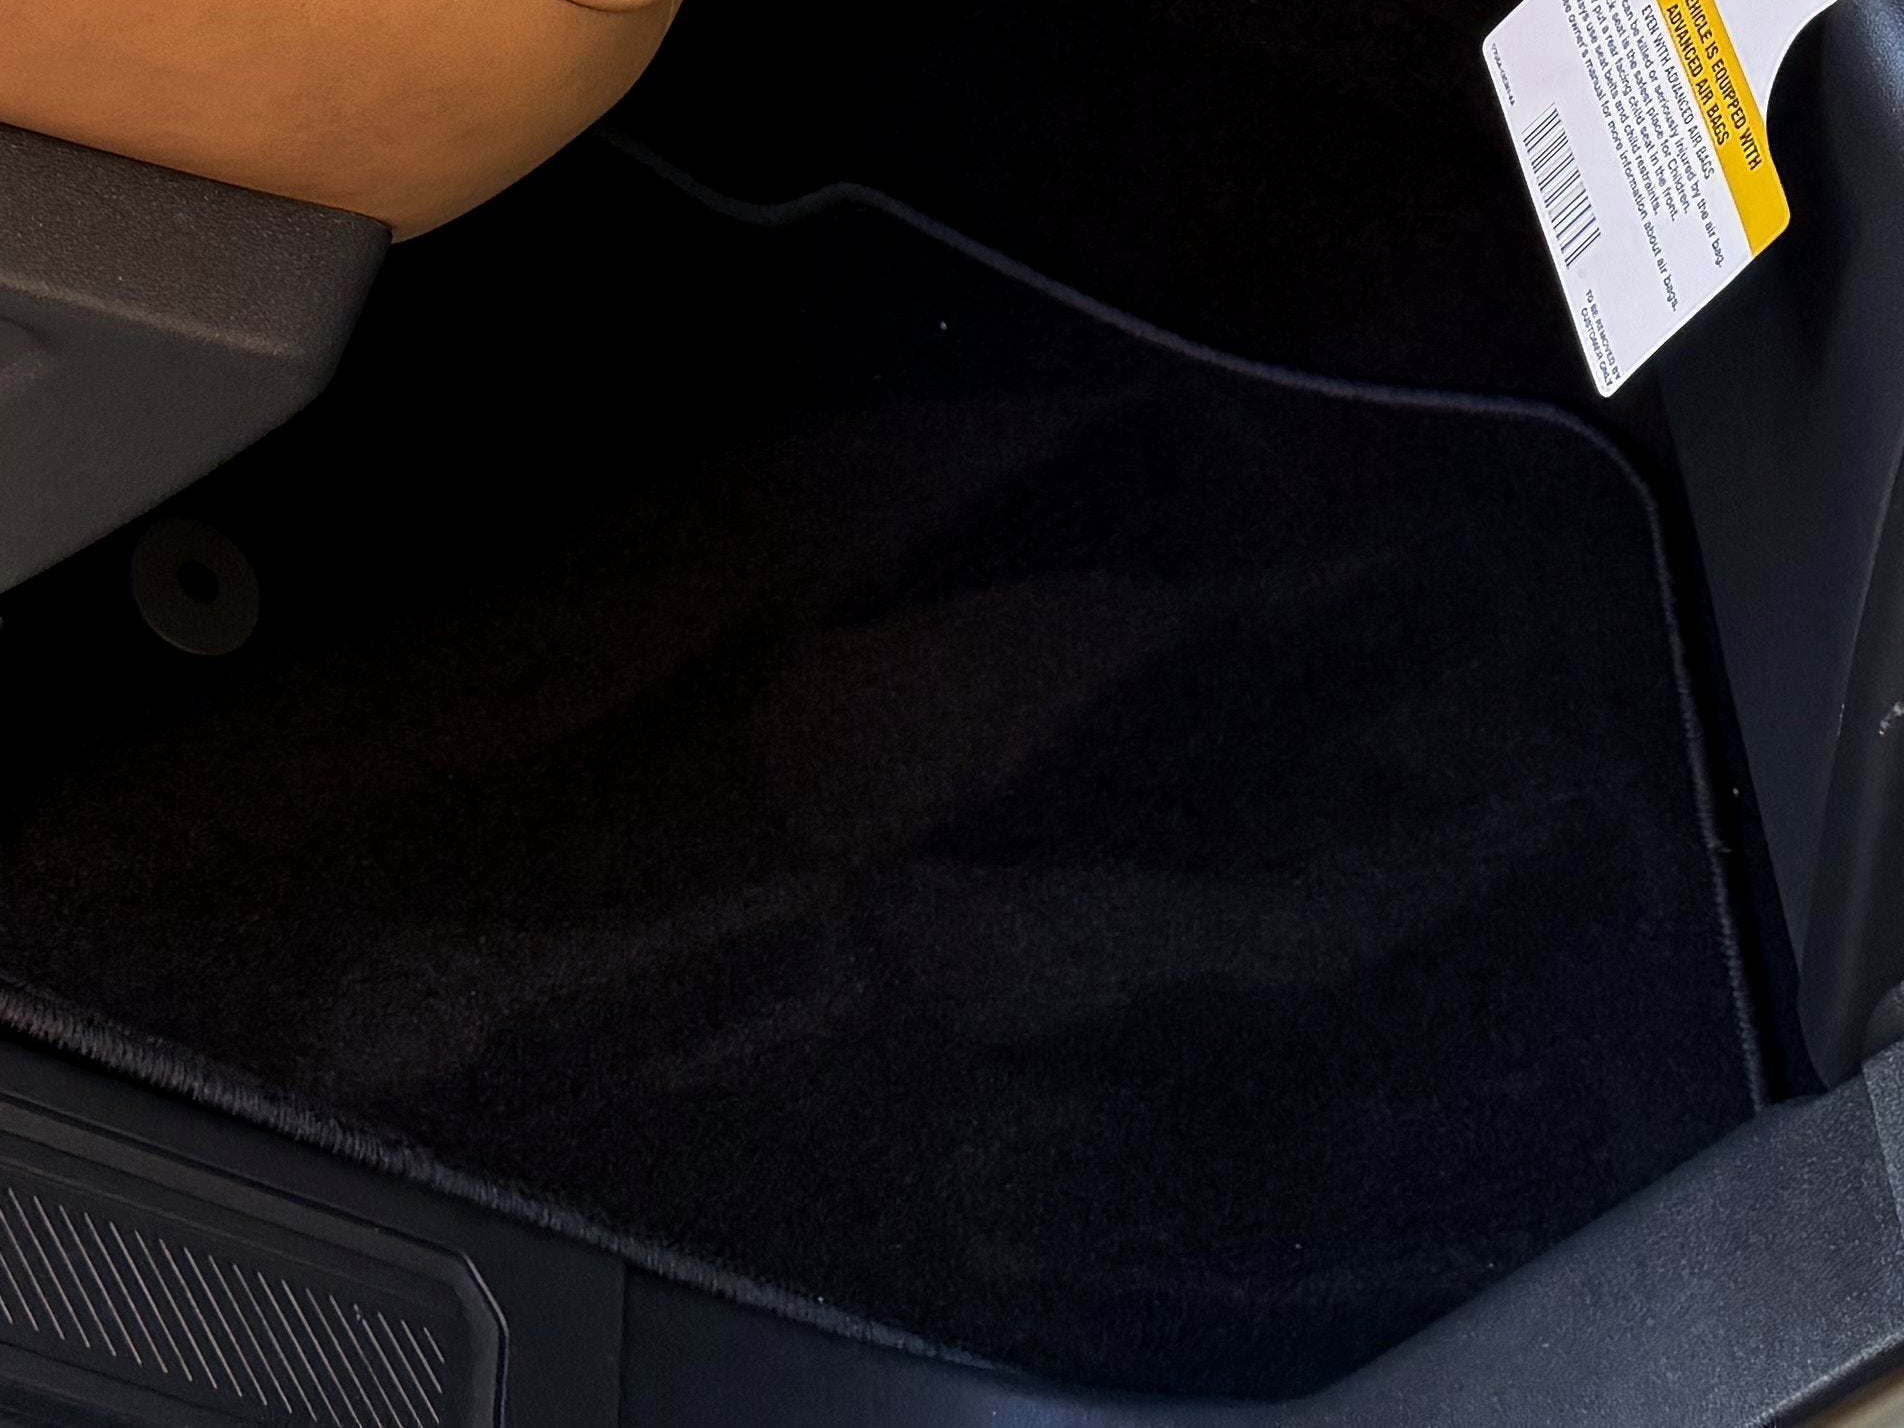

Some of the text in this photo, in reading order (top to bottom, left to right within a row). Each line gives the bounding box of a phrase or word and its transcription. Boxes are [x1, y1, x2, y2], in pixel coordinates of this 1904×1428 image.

[1591, 3, 1608, 26] put
[1601, 24, 1610, 35] a
[1611, 11, 1627, 38] seat
[1604, 33, 1619, 58] rear
[1621, 35, 1630, 50] is
[1625, 48, 1638, 70] the
[1704, 40, 1719, 61] IS
[1614, 56, 1633, 97] facing
[1633, 69, 1653, 107] safest
[1641, 3, 1715, 180] EVEN WITH ADVANCED AIR BAGS
[1665, 3, 1730, 146] ADVANCED AIR BAGS
[1627, 95, 1646, 126] child
[1710, 57, 1747, 130] EQUIPPED
[1585, 21, 1599, 44] use
[1594, 43, 1610, 71] seat
[1603, 67, 1619, 100] belts
[1614, 99, 1630, 124] and
[1623, 123, 1642, 155] child
[1634, 153, 1661, 216] restraints.
[1645, 105, 1664, 140] place
[1629, 18, 1640, 37] be
[1635, 34, 1655, 70] killed
[1648, 69, 1658, 83] or
[1653, 83, 1679, 139] seriously
[1674, 136, 1698, 182] injured
[1690, 179, 1702, 199] by
[1696, 197, 1710, 221] the
[1704, 220, 1716, 238] air
[1710, 237, 1725, 268] bag.
[1639, 125, 1655, 153] seat
[1659, 138, 1672, 158] for
[1738, 126, 1763, 171] WITH
[1567, 13, 1589, 59] owner's
[1584, 57, 1607, 102] manual
[1600, 99, 1612, 119] for
[1607, 119, 1624, 151] more
[1618, 149, 1649, 221] information
[1642, 220, 1662, 257] about
[1656, 257, 1668, 274] air
[1662, 273, 1679, 312] bags.
[1649, 150, 1660, 167] in
[1654, 164, 1667, 188] the
[1666, 157, 1691, 215] Children.
[1661, 186, 1679, 222] front.
[1580, 306, 1613, 387] CUSTOMER ONLY
[1585, 288, 1622, 381] TO BE REMOVED BY
